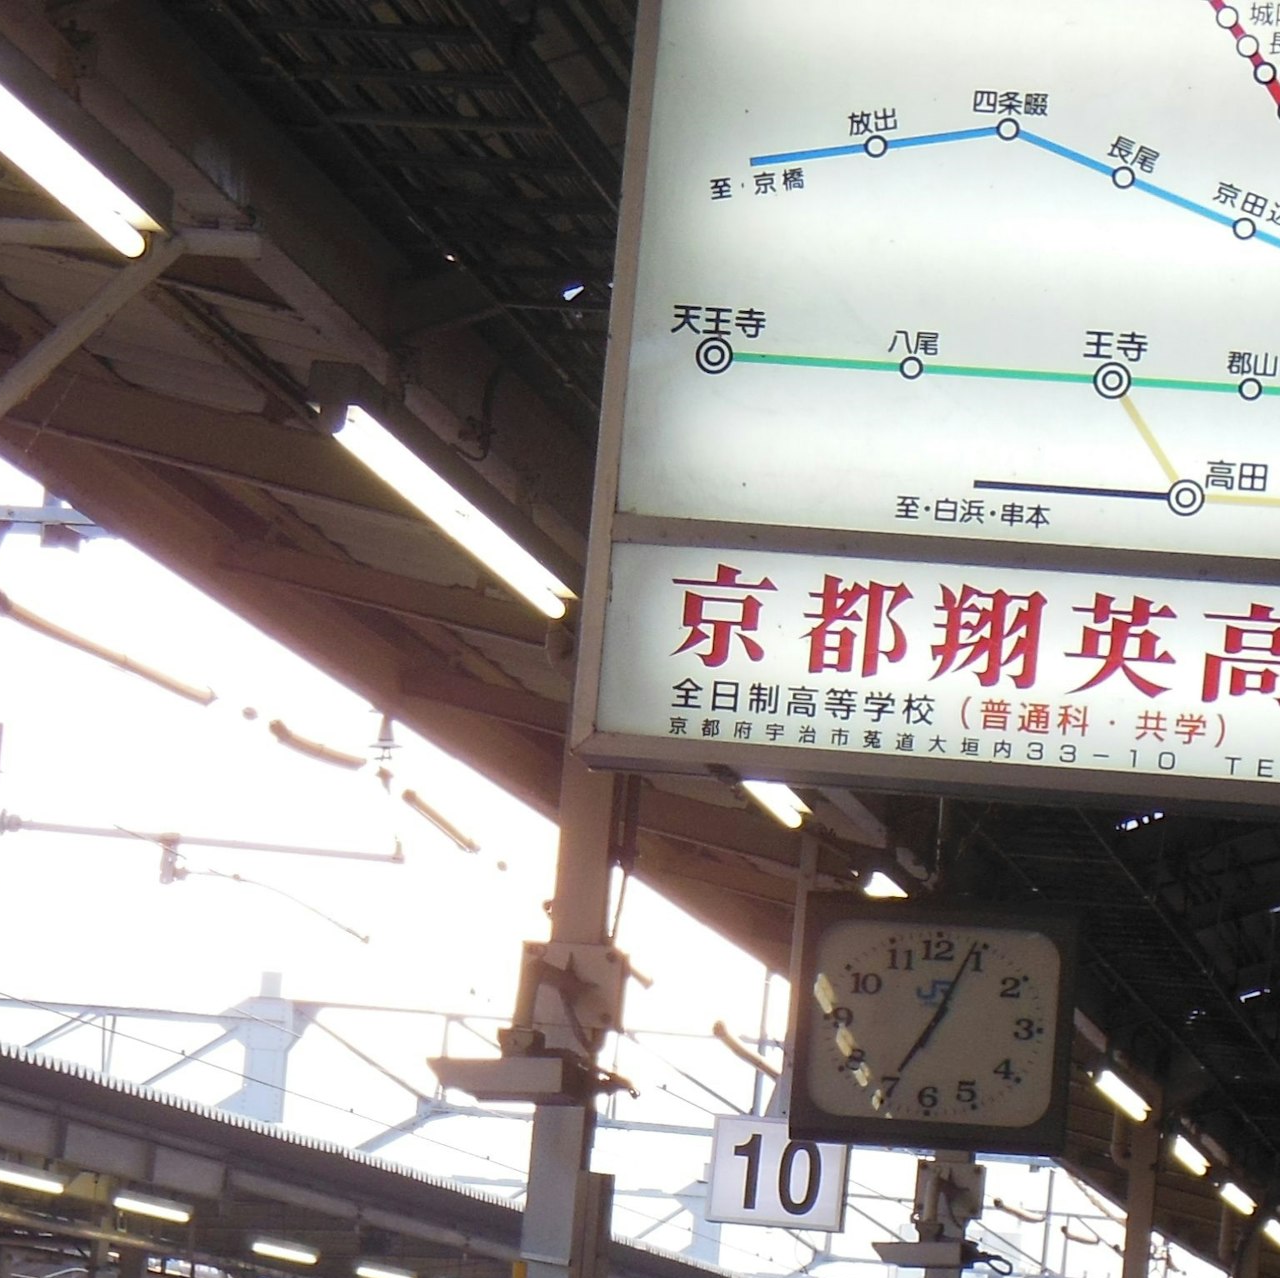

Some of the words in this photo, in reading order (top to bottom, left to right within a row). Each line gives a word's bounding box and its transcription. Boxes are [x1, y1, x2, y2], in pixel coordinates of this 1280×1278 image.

[972, 90, 1049, 118] 四条畷
[848, 108, 898, 137] 放出
[1107, 135, 1160, 174] 長尾
[670, 305, 767, 338] 天王寺
[887, 330, 939, 357] 八尾
[1083, 331, 1148, 362] 王寺
[1227, 351, 1279, 378] 郡山
[1204, 461, 1268, 492] 高田
[671, 677, 936, 725] 全日制高等学校
[888, 948, 914, 970] 11
[922, 939, 955, 961] 12
[971, 949, 983, 972] 1
[850, 972, 883, 994] 10
[999, 977, 1022, 998] 2
[1013, 1018, 1035, 1040] 3
[993, 1059, 1015, 1080] 4
[881, 1076, 901, 1098] 7
[917, 1086, 939, 1108] 6
[956, 1080, 977, 1103] 5
[733, 1133, 822, 1216] 10
